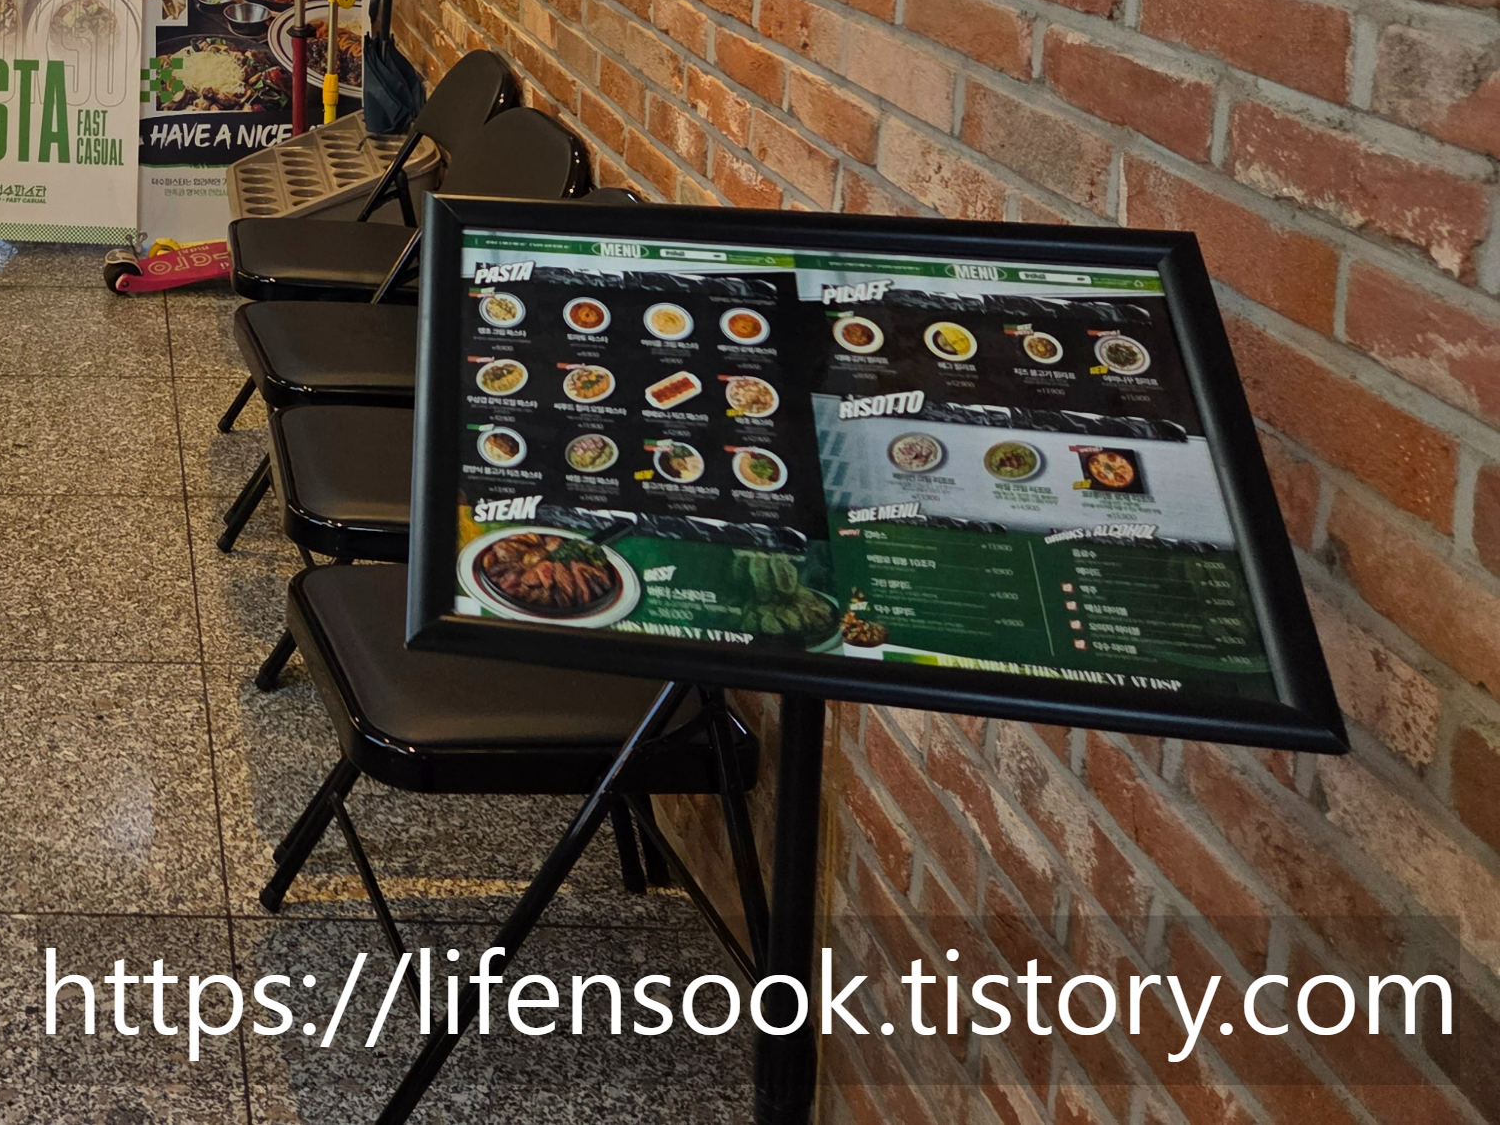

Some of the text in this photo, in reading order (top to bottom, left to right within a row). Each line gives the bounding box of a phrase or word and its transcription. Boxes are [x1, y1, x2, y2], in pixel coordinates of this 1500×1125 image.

[77, 109, 108, 137] FAST
[150, 123, 211, 151] HAVE
[213, 125, 231, 150] A
[76, 138, 125, 166] CASUAL
[600, 242, 642, 259] MENU
[474, 261, 536, 284] PASTA
[954, 263, 999, 281] MENU
[823, 280, 892, 305] PILAFF
[838, 391, 924, 419] RISOTTO
[474, 495, 542, 522] STEAK
[848, 502, 921, 523] SIDE MENU
[1093, 524, 1158, 541] ALCOHOL
[937, 655, 1020, 674] REMEMBER
[1021, 663, 1060, 678] THIS
[1061, 667, 1125, 687] MOMENT
[1151, 678, 1182, 692] DSP
